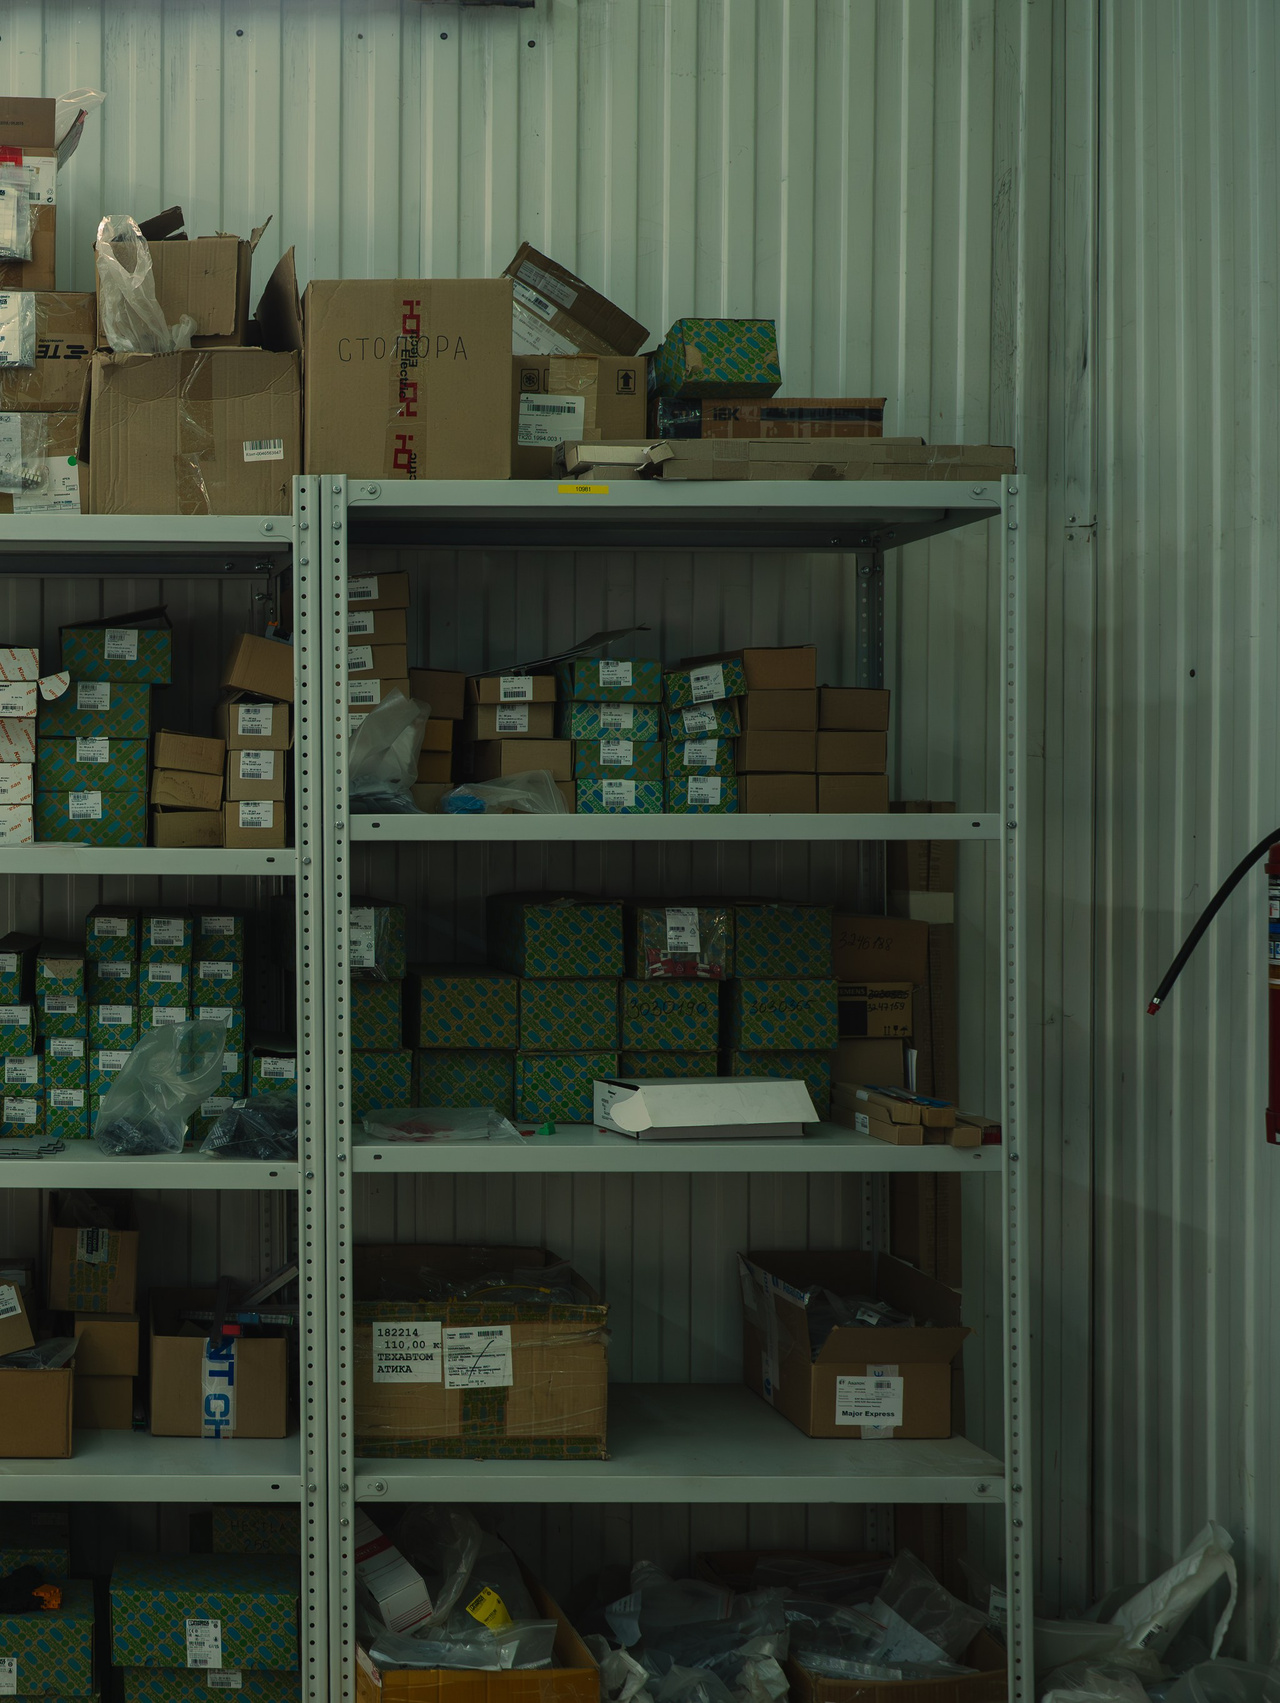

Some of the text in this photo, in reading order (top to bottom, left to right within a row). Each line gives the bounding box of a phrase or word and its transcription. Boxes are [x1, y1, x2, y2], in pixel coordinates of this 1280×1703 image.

[338, 335, 468, 362] СТОПОРА
[840, 987, 866, 995] EMENS
[377, 1328, 419, 1337] 182214
[384, 1341, 426, 1350] 110,00
[377, 1353, 434, 1361] ТЕХАВТОМ
[377, 1365, 412, 1373] АТИКА
